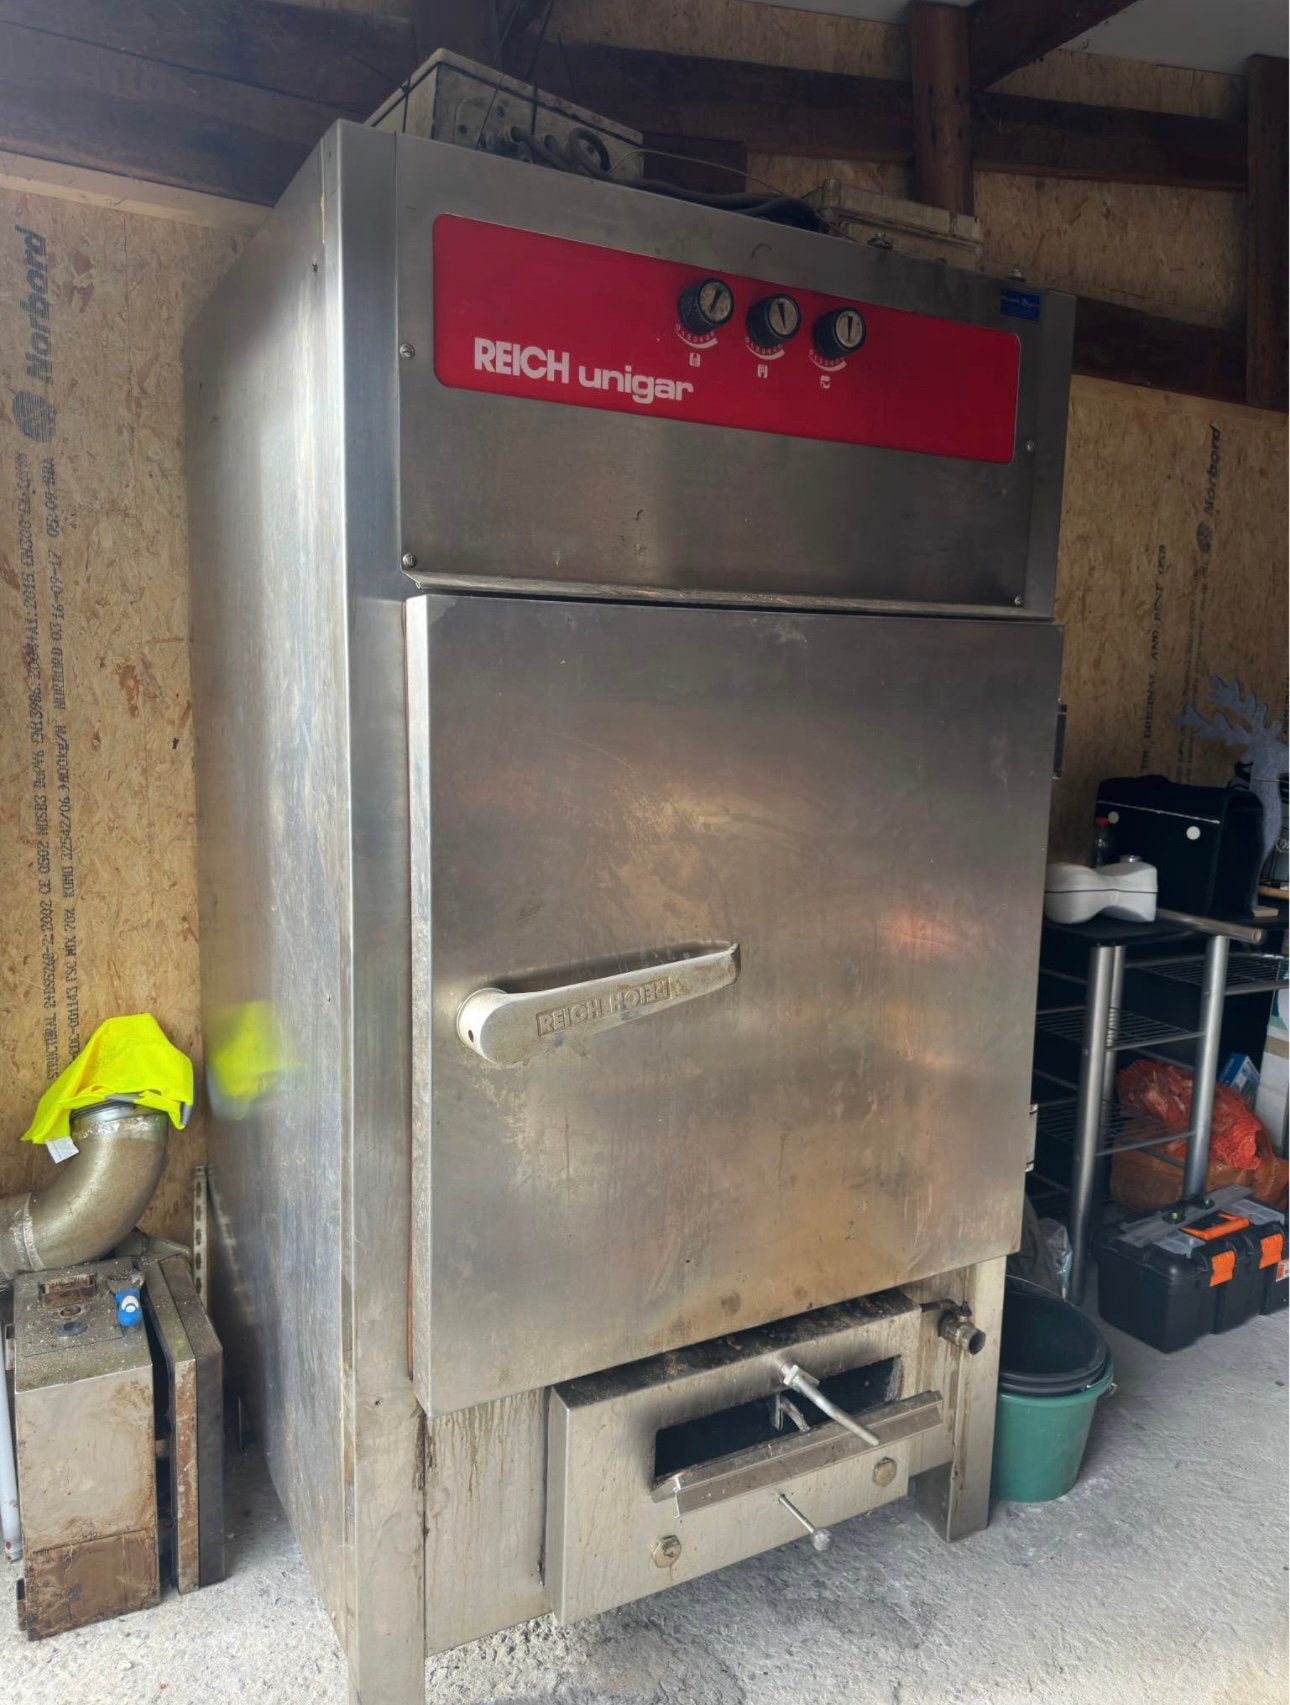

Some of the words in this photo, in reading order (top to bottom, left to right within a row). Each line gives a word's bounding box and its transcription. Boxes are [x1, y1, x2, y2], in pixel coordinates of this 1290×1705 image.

[14, 223, 54, 384] Norbord
[474, 337, 570, 385] REICH
[578, 364, 694, 404] unigar
[1202, 424, 1221, 516] Norbord
[38, 879, 51, 895] CE
[537, 997, 603, 1035] REICH
